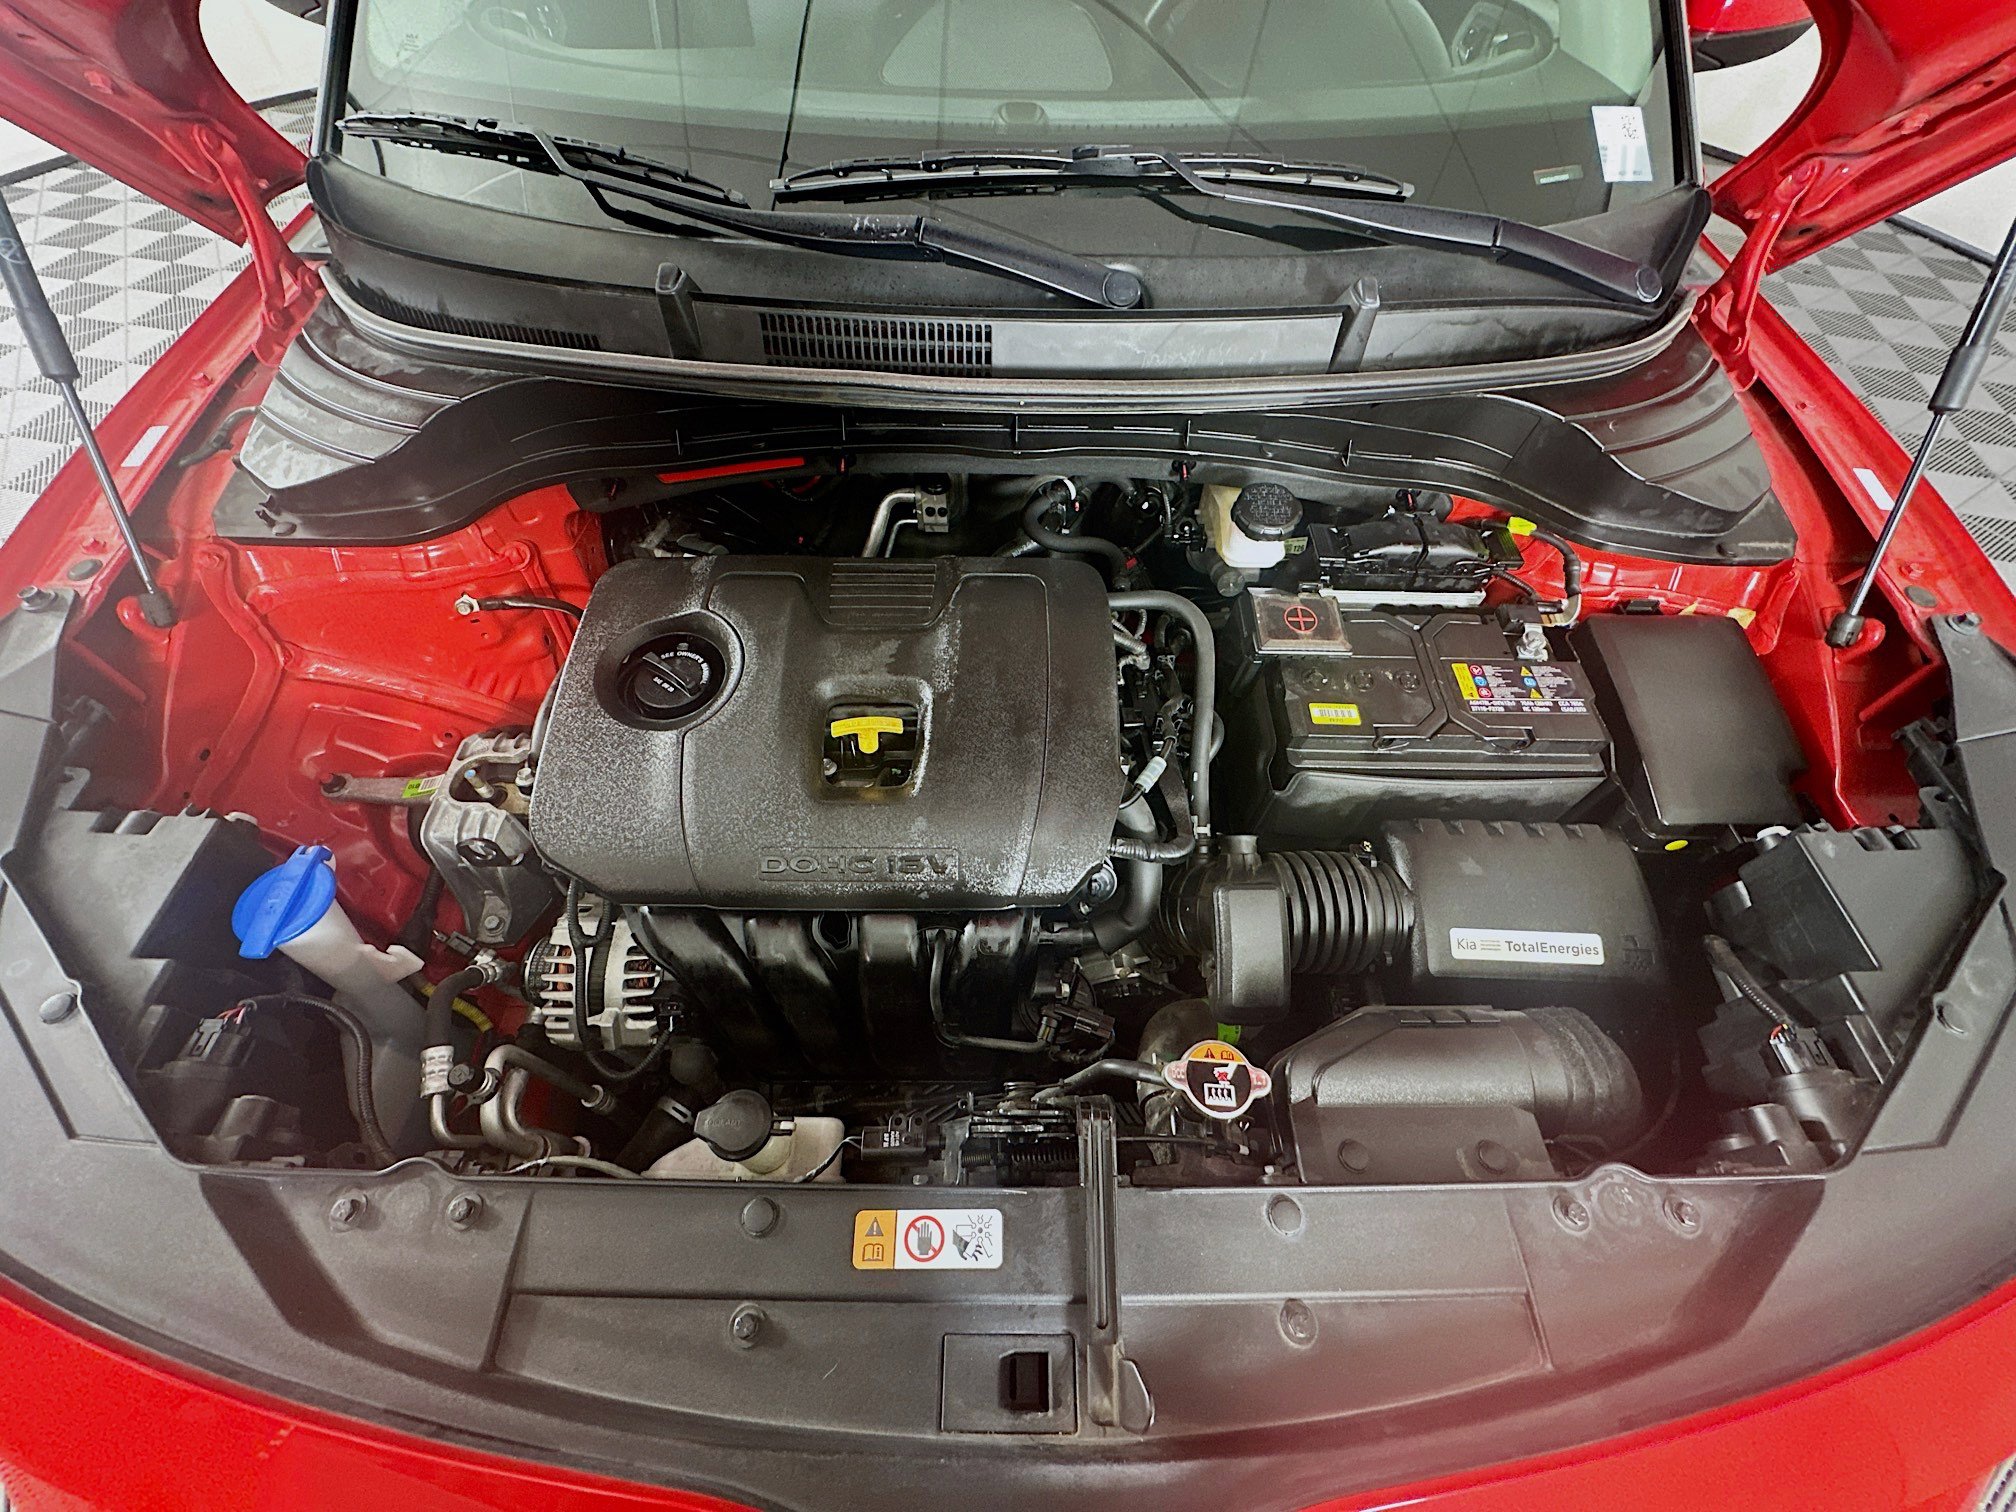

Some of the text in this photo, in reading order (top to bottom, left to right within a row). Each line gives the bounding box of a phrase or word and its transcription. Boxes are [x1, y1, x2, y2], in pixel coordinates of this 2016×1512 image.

[660, 651, 675, 660] SEE
[761, 854, 953, 876] DOHC 16V
[1456, 938, 1600, 957] Kia TotalEnergies
